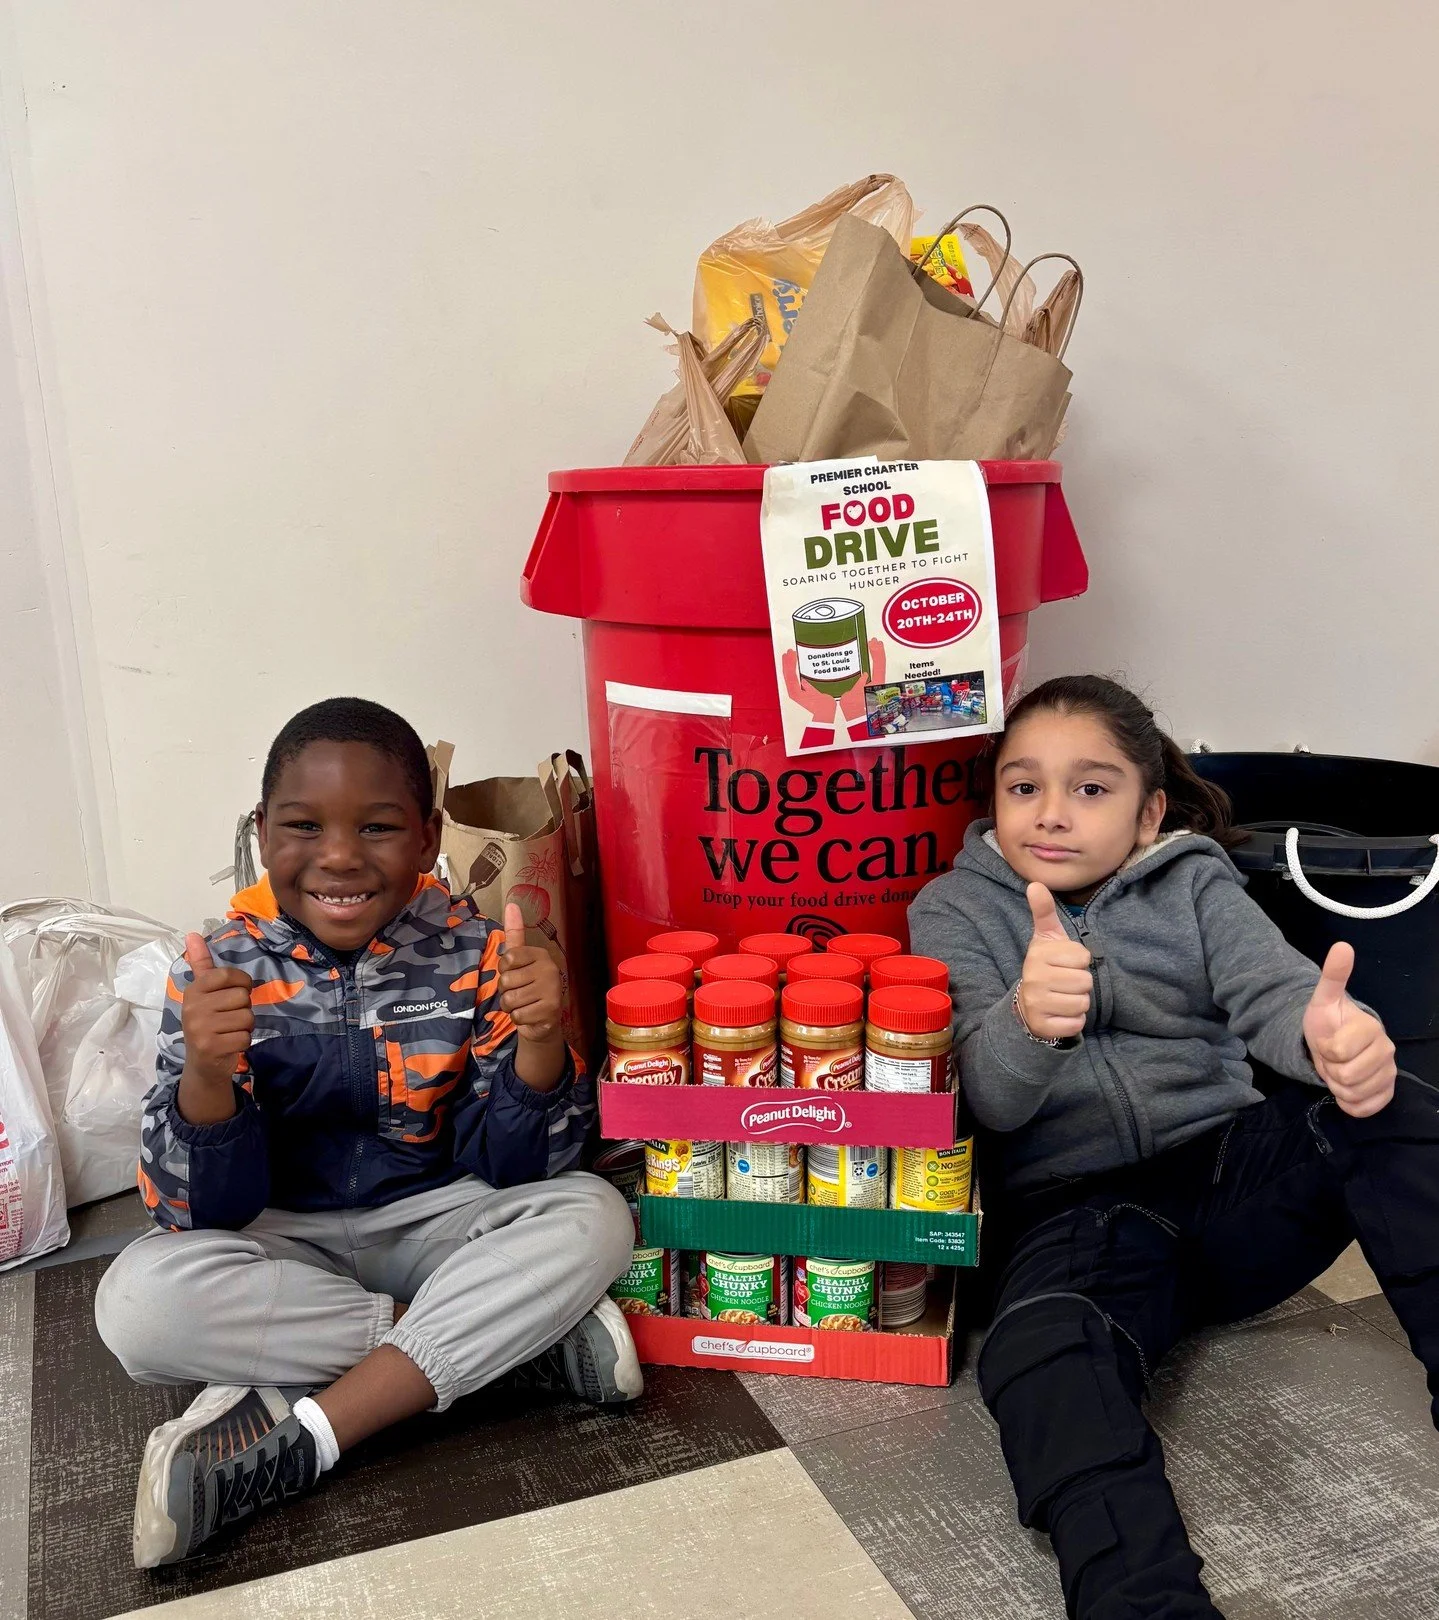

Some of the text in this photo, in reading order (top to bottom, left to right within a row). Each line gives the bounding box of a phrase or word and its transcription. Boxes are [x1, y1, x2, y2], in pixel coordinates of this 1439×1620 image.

[810, 463, 919, 484] PREMIER CHARTER
[843, 480, 891, 495] SCHOOL
[821, 494, 915, 530] FOOD
[804, 519, 940, 569] DRIVE
[782, 553, 969, 587] SOARING TOGETHER TO FIGHT
[849, 576, 900, 590] HUNGER
[901, 592, 965, 611] OCTOBER
[897, 608, 973, 630] 20TH-24TH
[807, 650, 843, 660] Donations
[832, 657, 850, 665] Louis
[909, 660, 935, 670] Items
[904, 668, 941, 680] Needed!
[694, 746, 983, 837] Together
[698, 829, 949, 885] we can.
[703, 888, 742, 909] Drop
[747, 895, 784, 910] your
[790, 891, 828, 907] food
[834, 890, 876, 907] drive
[393, 1000, 449, 1014] LONDON FOG
[627, 1059, 669, 1071] Peanut Delight
[833, 1057, 852, 1071] Peanut
[749, 1102, 838, 1128] Peanut Delight
[951, 1147, 966, 1155] ITALIA
[941, 1162, 953, 1170] NO
[632, 1249, 660, 1260] pboard
[708, 1258, 771, 1272] chef's cupboard
[810, 1263, 873, 1275] chef's cupboard
[714, 1270, 764, 1281] HEALTHY
[816, 1276, 866, 1286] HEALTHY
[630, 1284, 659, 1293] NOODLE
[711, 1277, 768, 1291] CHUNKY
[812, 1282, 869, 1295] CHUNKY
[711, 1293, 770, 1305] CHICKEN NOODLE
[811, 1298, 871, 1309] CHICKEN NOODLE
[700, 1340, 806, 1357] chef's cupboard
